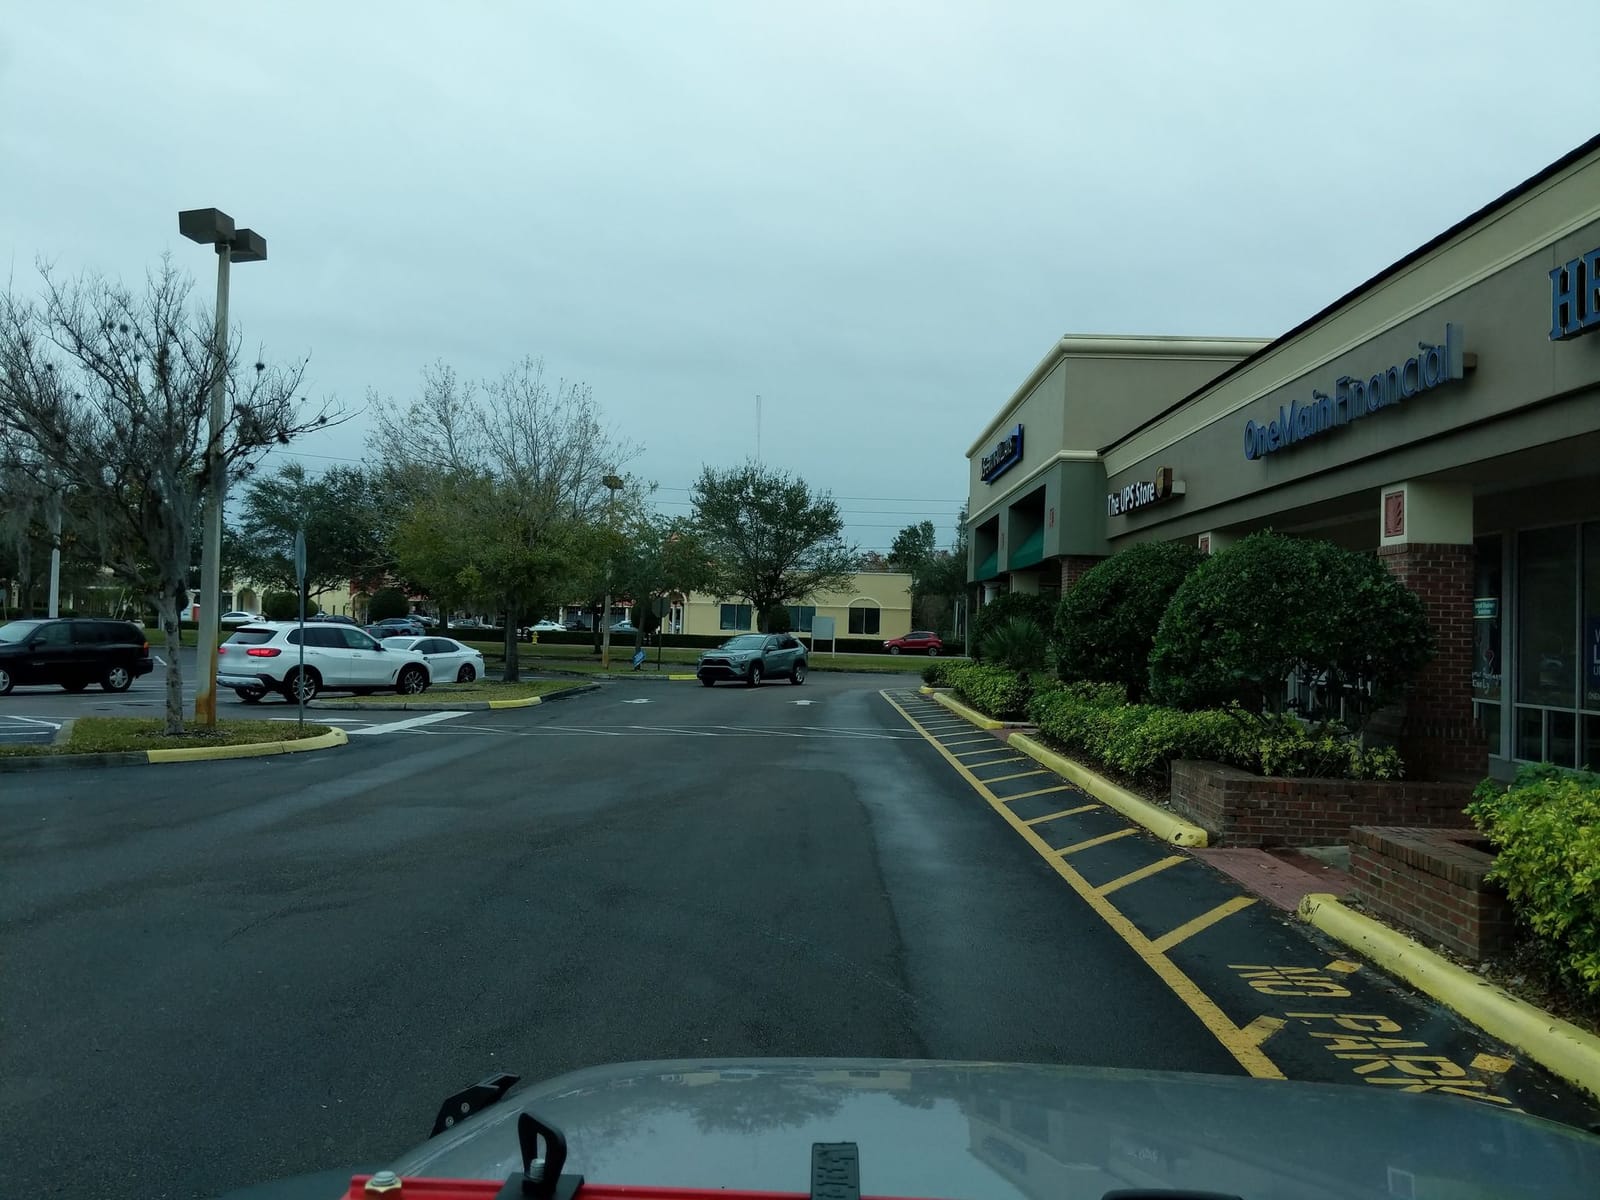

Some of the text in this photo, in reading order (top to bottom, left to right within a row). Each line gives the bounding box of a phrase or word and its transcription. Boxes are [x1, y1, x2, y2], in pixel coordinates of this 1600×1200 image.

[1244, 323, 1460, 460] OneMain Financial
[1107, 493, 1120, 517] The
[1120, 483, 1135, 513] UPS
[1135, 481, 1155, 507] Store
[1227, 964, 1351, 998] NO
